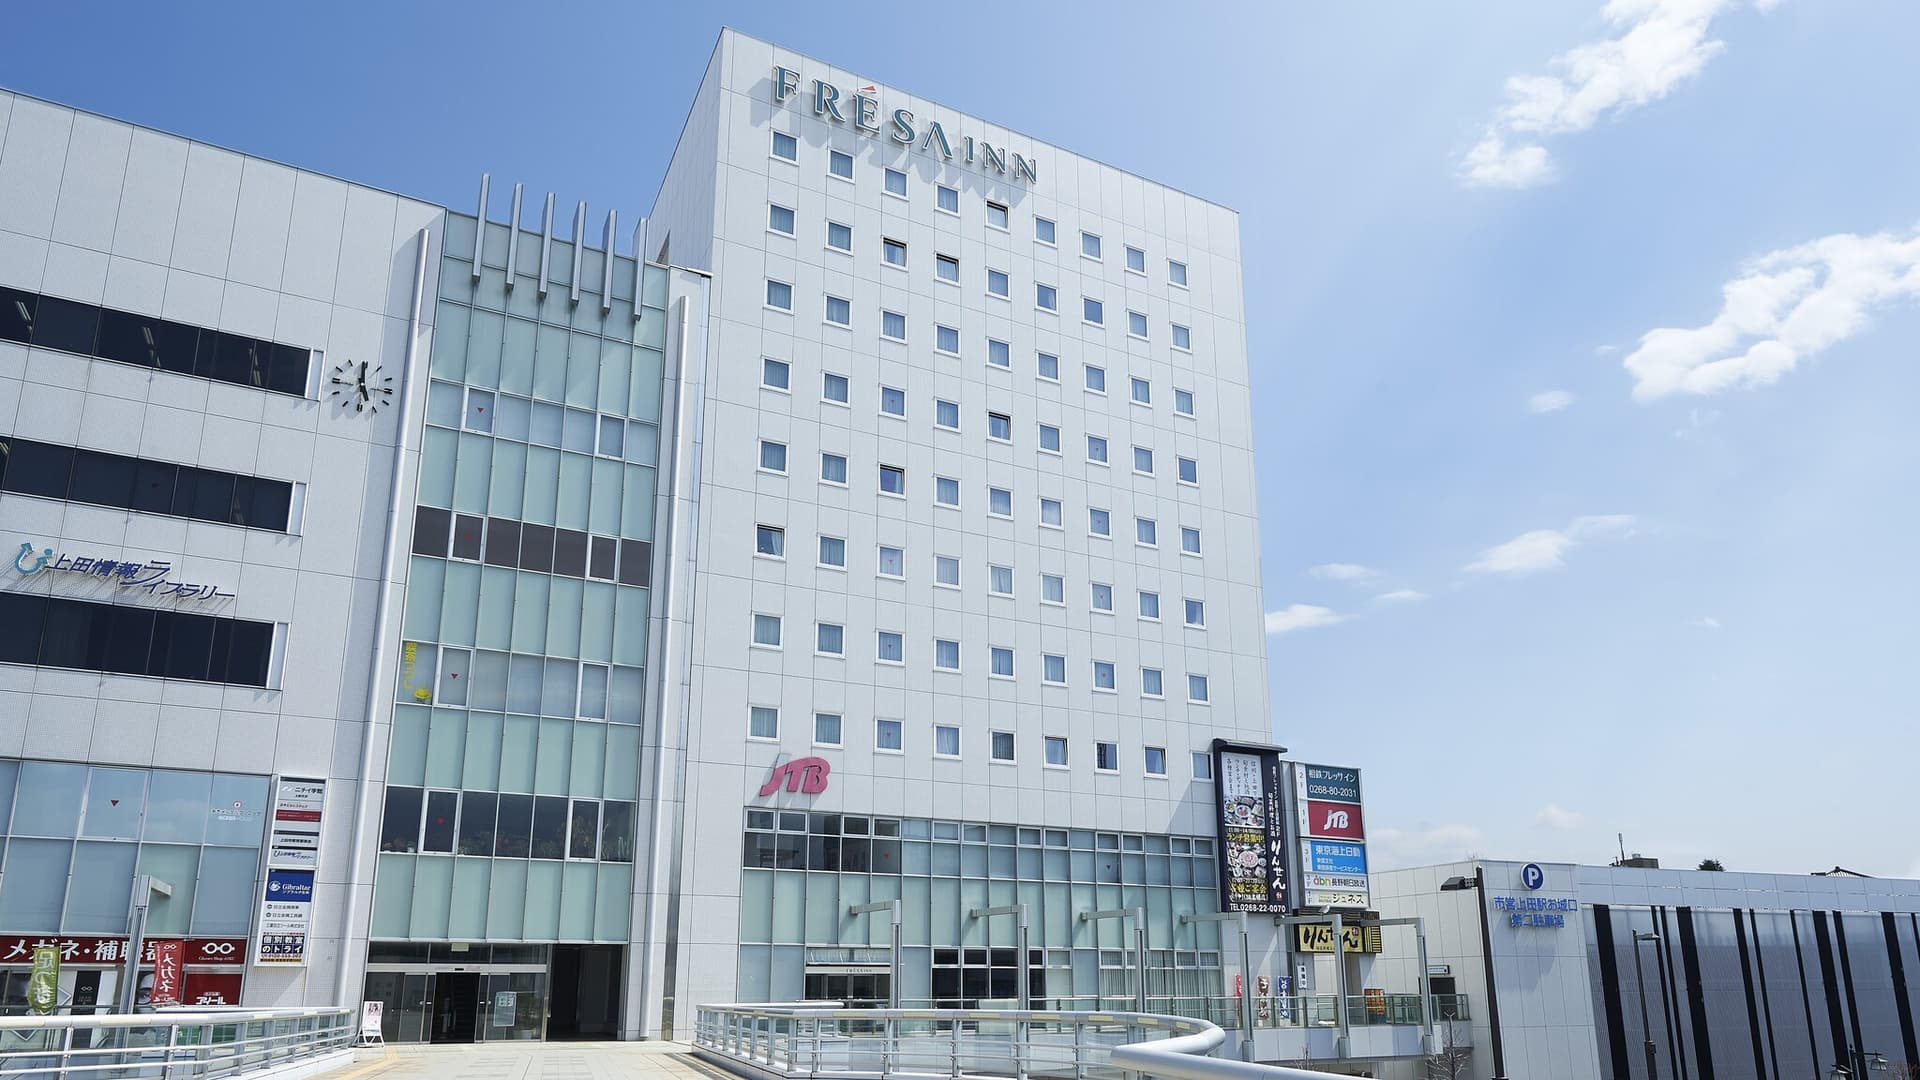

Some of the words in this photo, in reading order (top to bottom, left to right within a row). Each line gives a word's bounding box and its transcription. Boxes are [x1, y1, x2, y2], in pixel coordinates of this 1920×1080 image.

[964, 136, 1037, 184] INN
[47, 553, 235, 600] 上田情報ライブラリー
[759, 753, 831, 797] JTB
[1324, 810, 1348, 830] JTB
[1527, 867, 1540, 886] P
[1494, 896, 1578, 912] 市営上田駅お城口
[262, 945, 302, 954] のトライ
